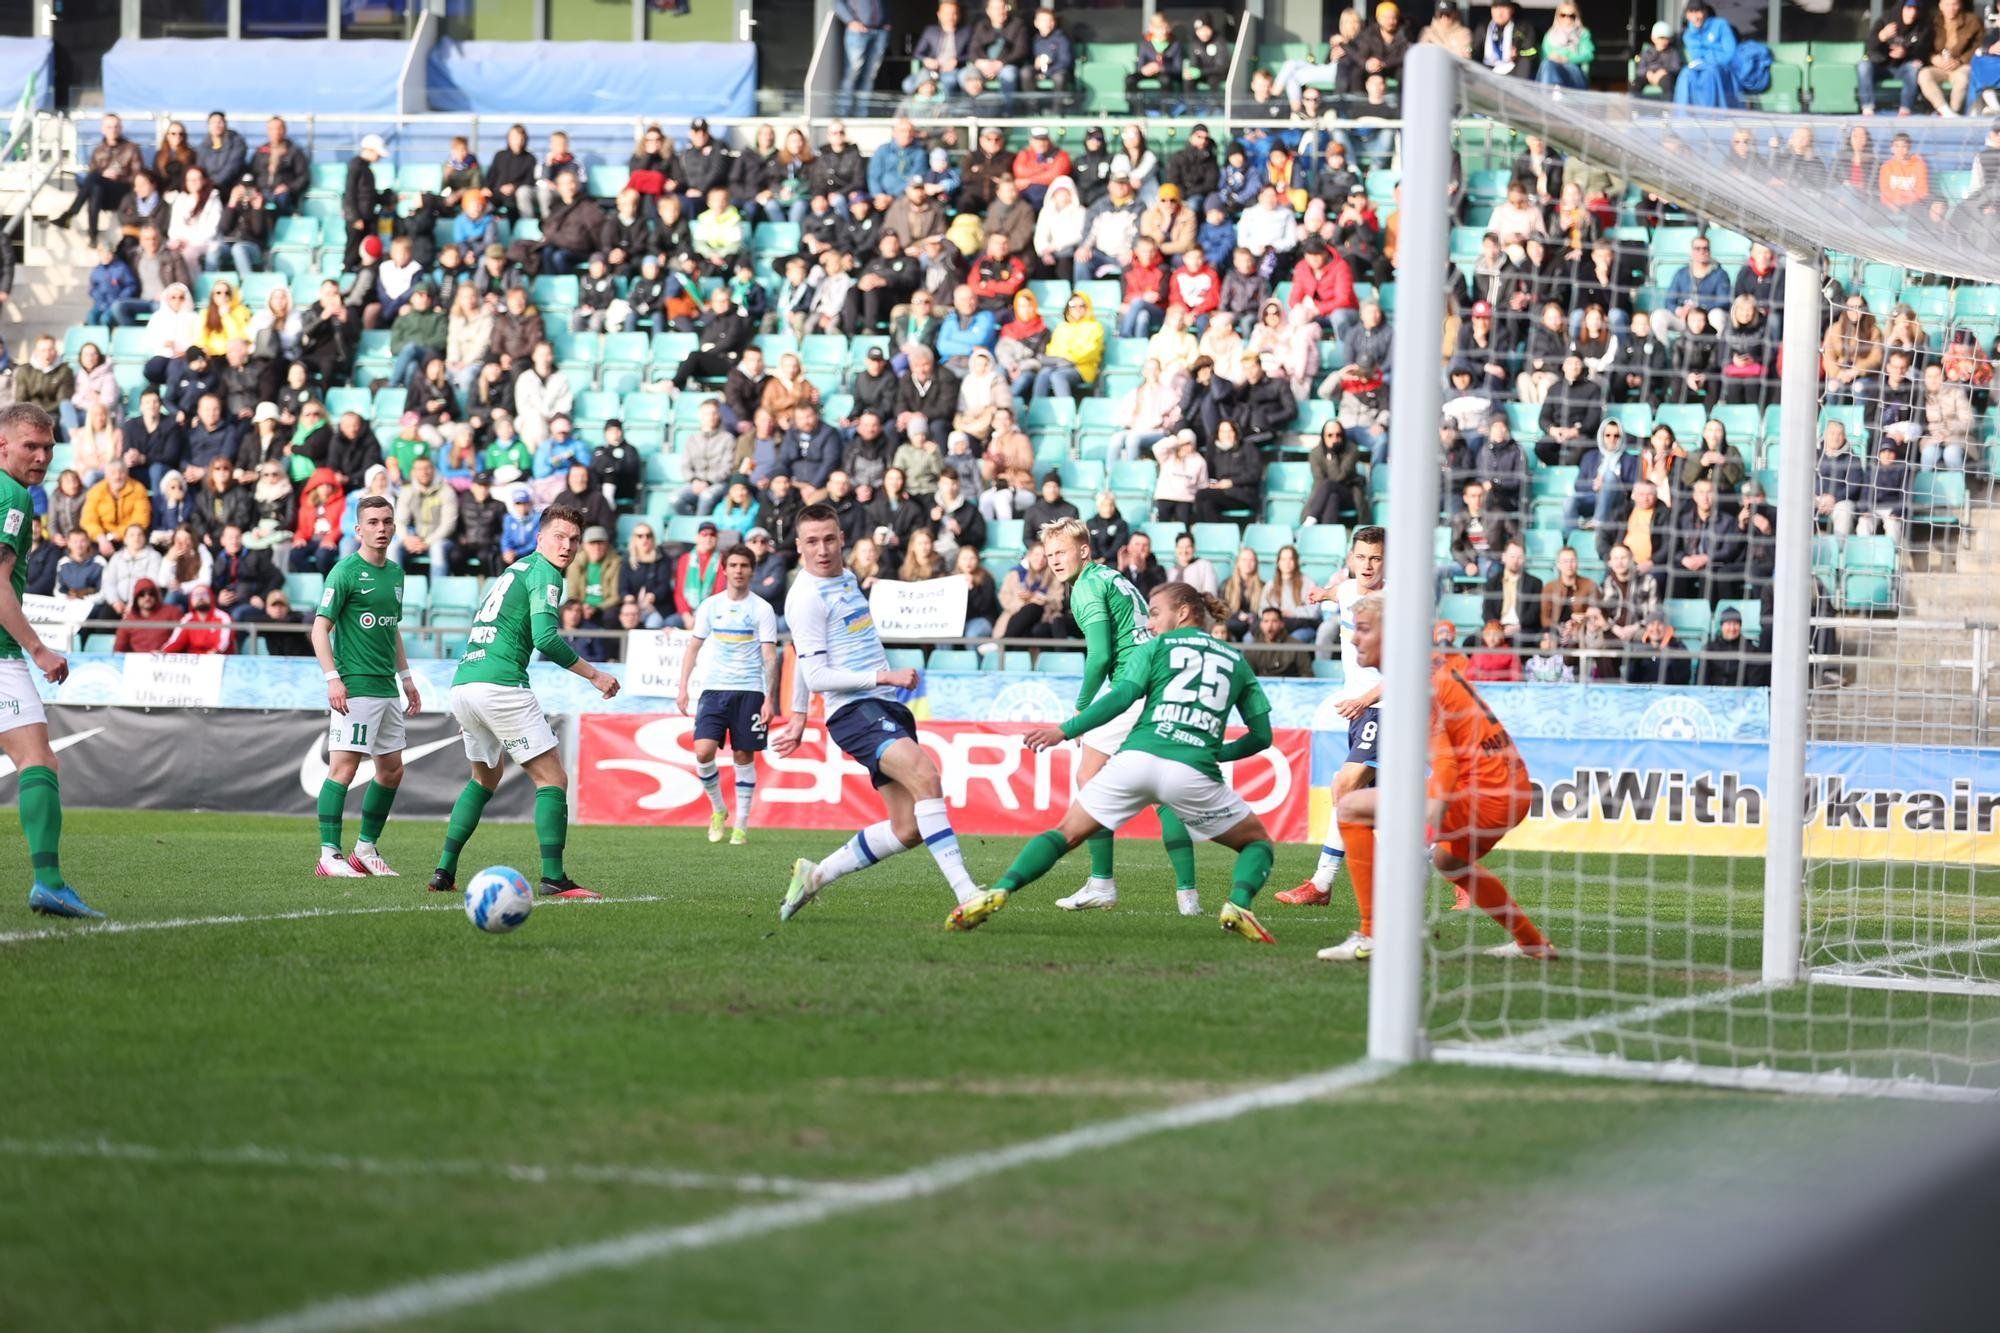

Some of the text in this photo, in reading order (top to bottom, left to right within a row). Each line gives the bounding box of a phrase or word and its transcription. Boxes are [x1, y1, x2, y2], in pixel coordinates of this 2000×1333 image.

[900, 606, 938, 614] With
[152, 670, 192, 685] With
[1162, 646, 1235, 711] 25
[351, 722, 367, 746] 11
[1361, 721, 1378, 742] 8
